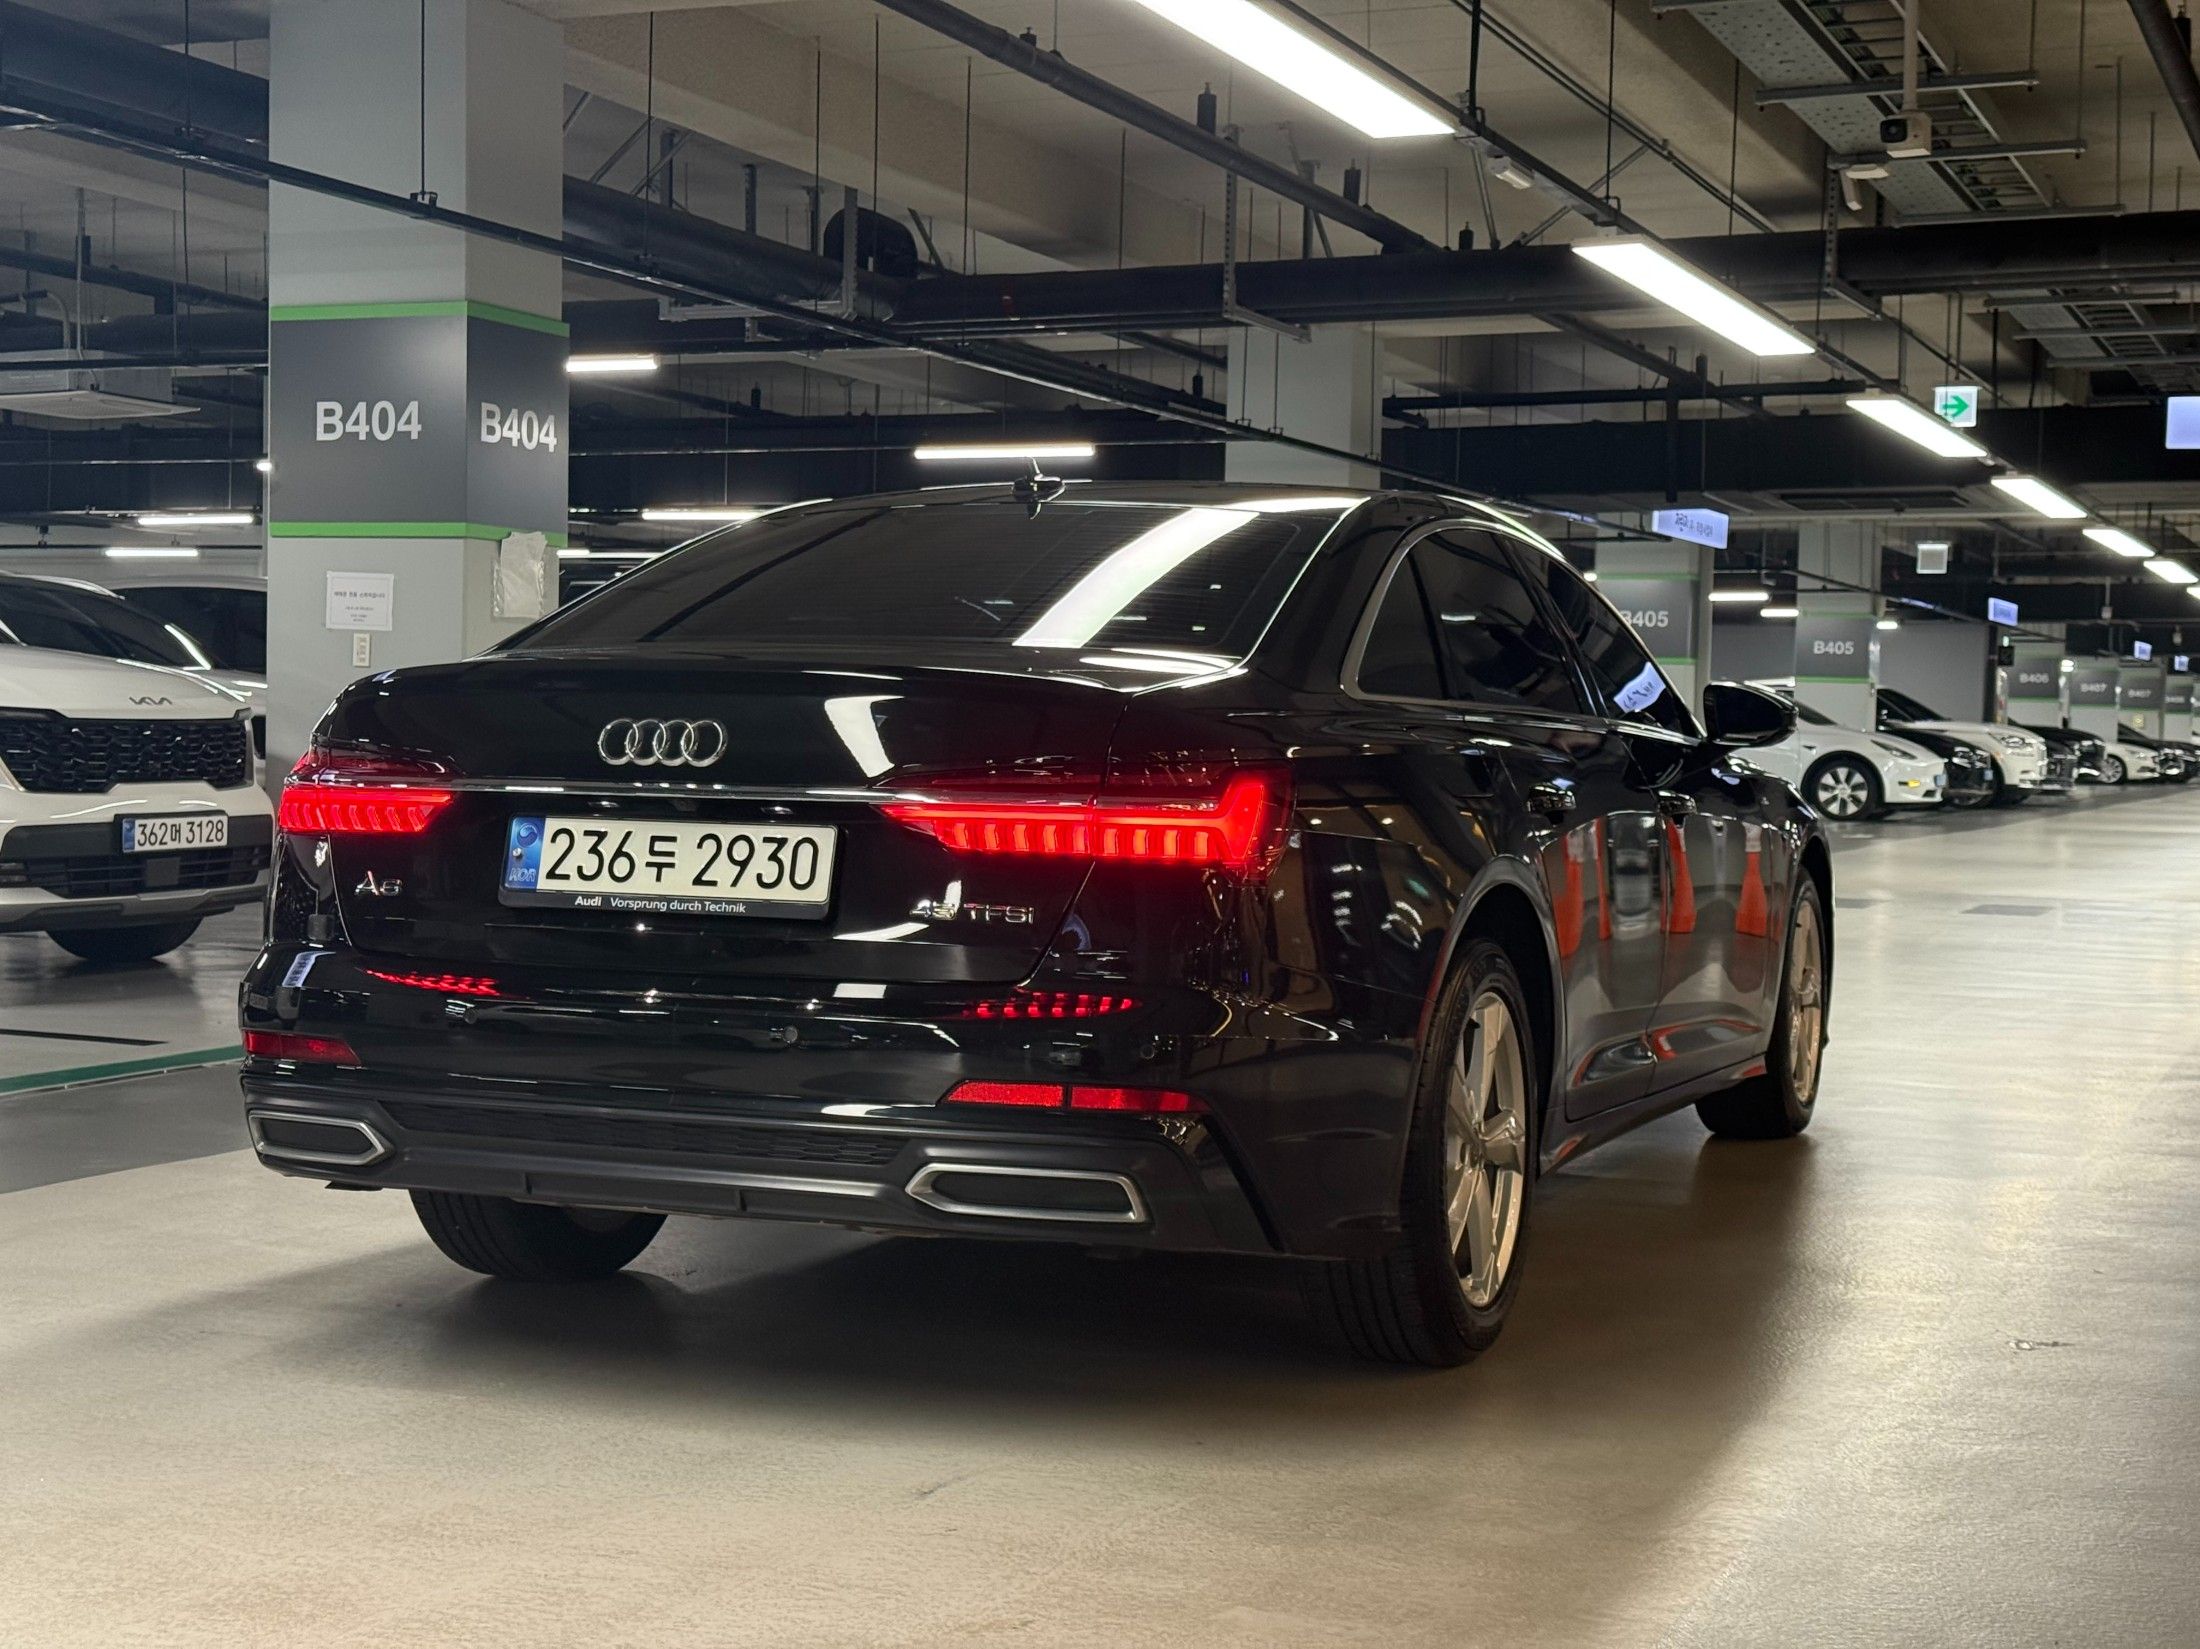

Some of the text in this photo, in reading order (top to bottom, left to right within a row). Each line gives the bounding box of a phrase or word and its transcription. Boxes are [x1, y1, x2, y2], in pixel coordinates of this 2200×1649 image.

[315, 400, 422, 441] B404
[480, 401, 558, 453] B404
[1812, 640, 1855, 656] B405
[137, 822, 182, 847] 362머
[185, 819, 225, 844] 3128
[545, 827, 820, 891] 236두 2930
[354, 870, 403, 897] A6
[508, 867, 537, 882] KOR
[574, 895, 746, 914] Audi Vorsprung durch Technik
